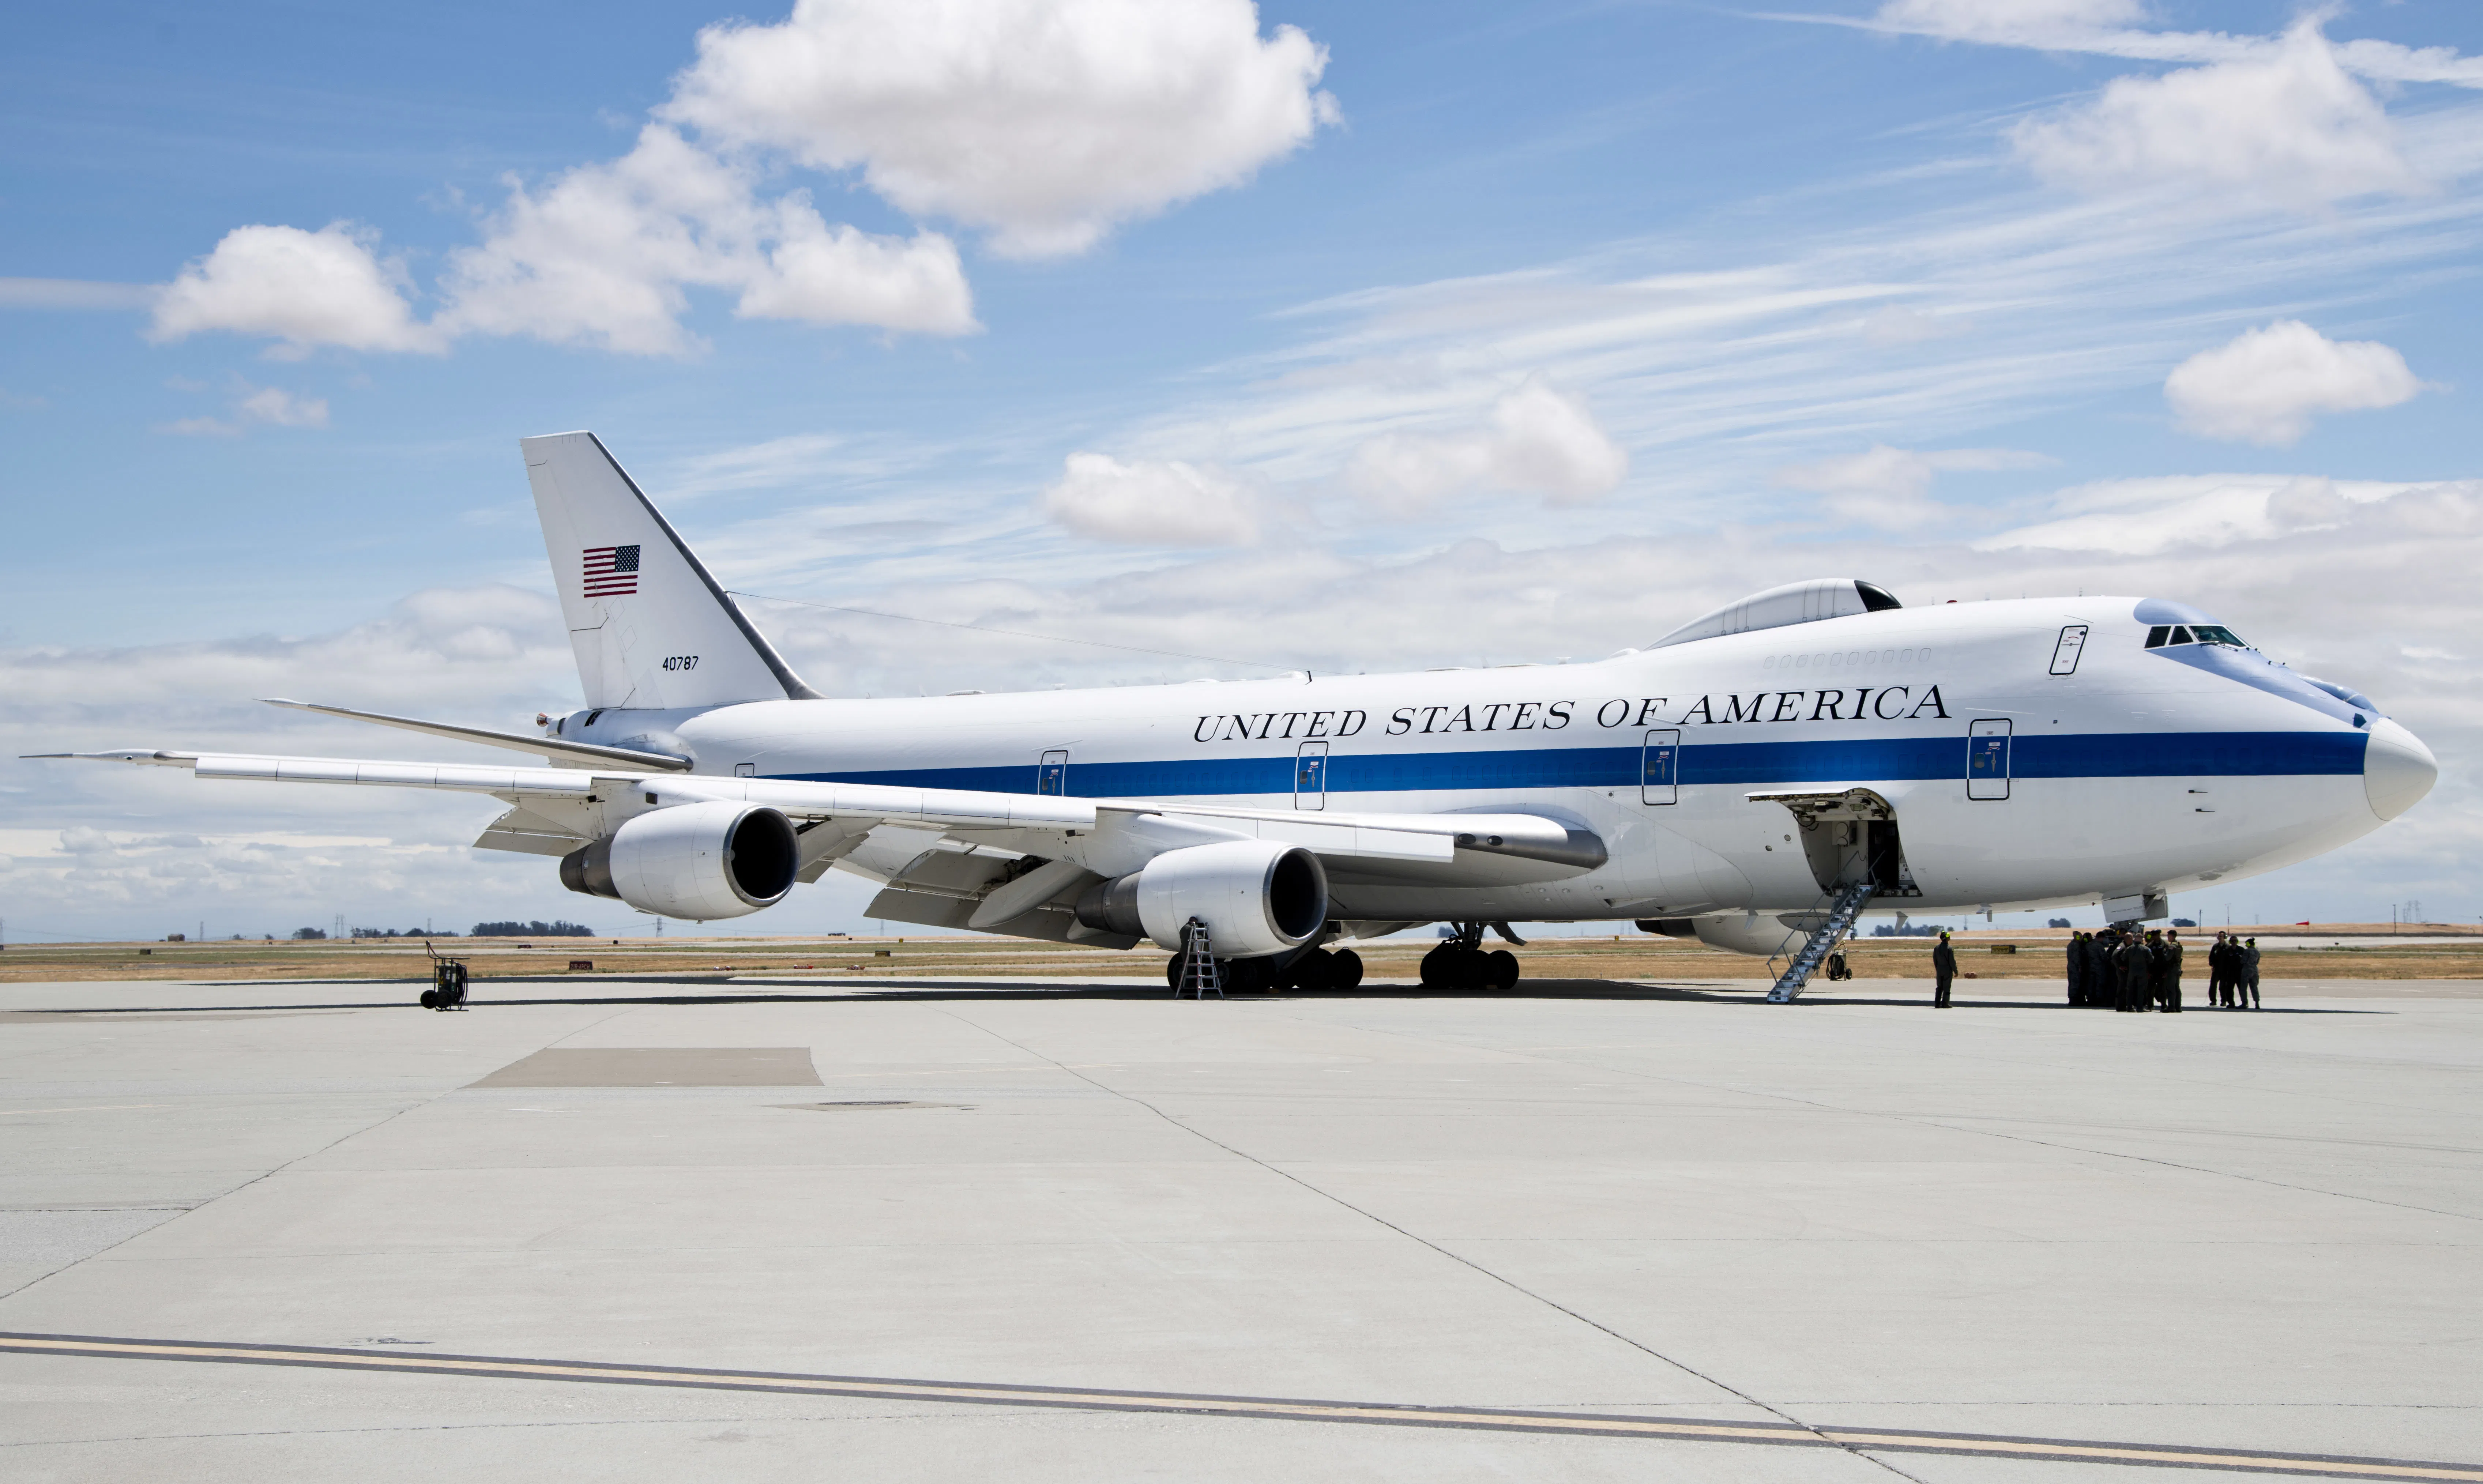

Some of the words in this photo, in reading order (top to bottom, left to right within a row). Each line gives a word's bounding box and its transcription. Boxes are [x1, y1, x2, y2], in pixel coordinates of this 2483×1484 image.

[662, 656, 699, 671] 40787
[1194, 710, 1367, 743] UNITED
[1385, 701, 1576, 735] STATES
[1597, 698, 1668, 728] OF
[1674, 684, 1953, 725] AMERICA
